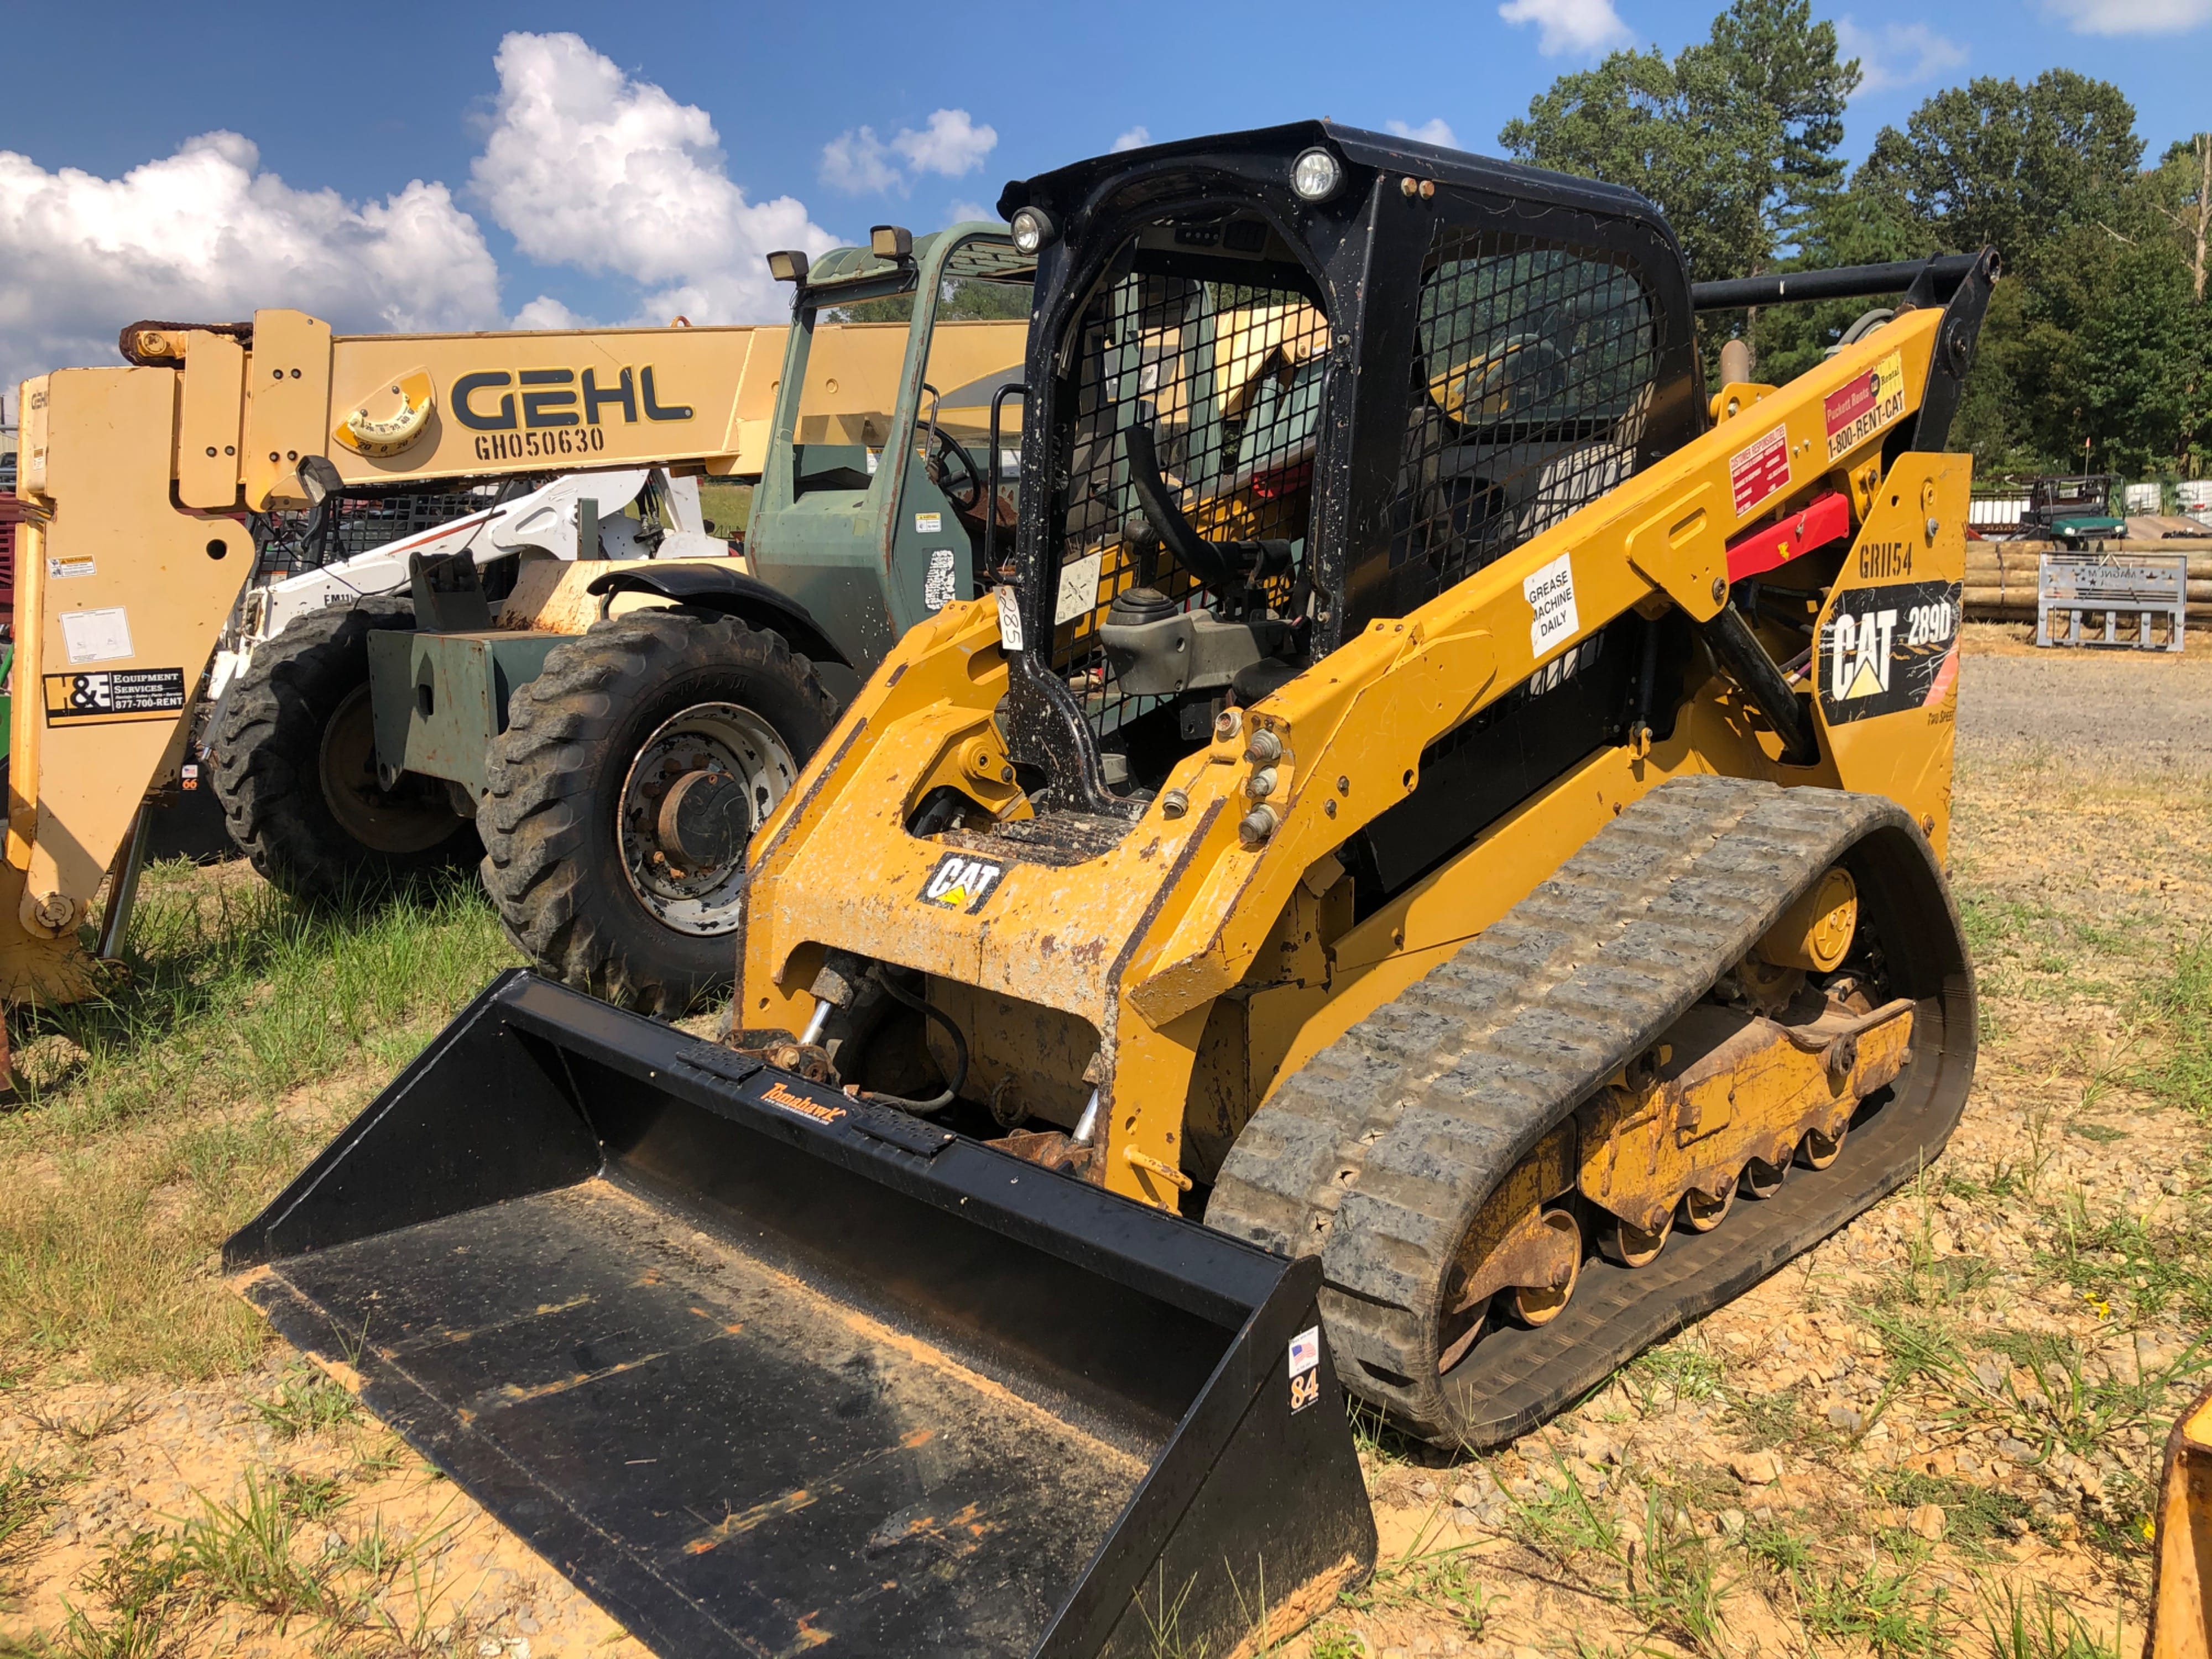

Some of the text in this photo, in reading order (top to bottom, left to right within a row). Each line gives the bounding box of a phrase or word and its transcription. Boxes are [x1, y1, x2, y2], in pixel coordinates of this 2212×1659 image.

[1880, 366, 1900, 386] Rental
[450, 363, 695, 431] GEHL
[1827, 388, 1869, 422] Puckett Rents
[1828, 390, 1903, 459] 1-800-RENT-CAT
[474, 427, 604, 460] GH050630
[1529, 570, 1568, 604] GREASE
[999, 596, 1021, 643] 285
[1541, 610, 1567, 637] DAILY
[1832, 602, 1951, 701] CAT 289D
[45, 674, 111, 710] H&E
[113, 673, 179, 684] EQUIPMENT
[114, 684, 164, 694] SERVICES
[115, 697, 182, 709] 877-700-RENT
[182, 779, 197, 789] 66
[927, 858, 1000, 906] CAT
[760, 1082, 847, 1123] Tomahawk
[1291, 1366, 1319, 1410] 84
